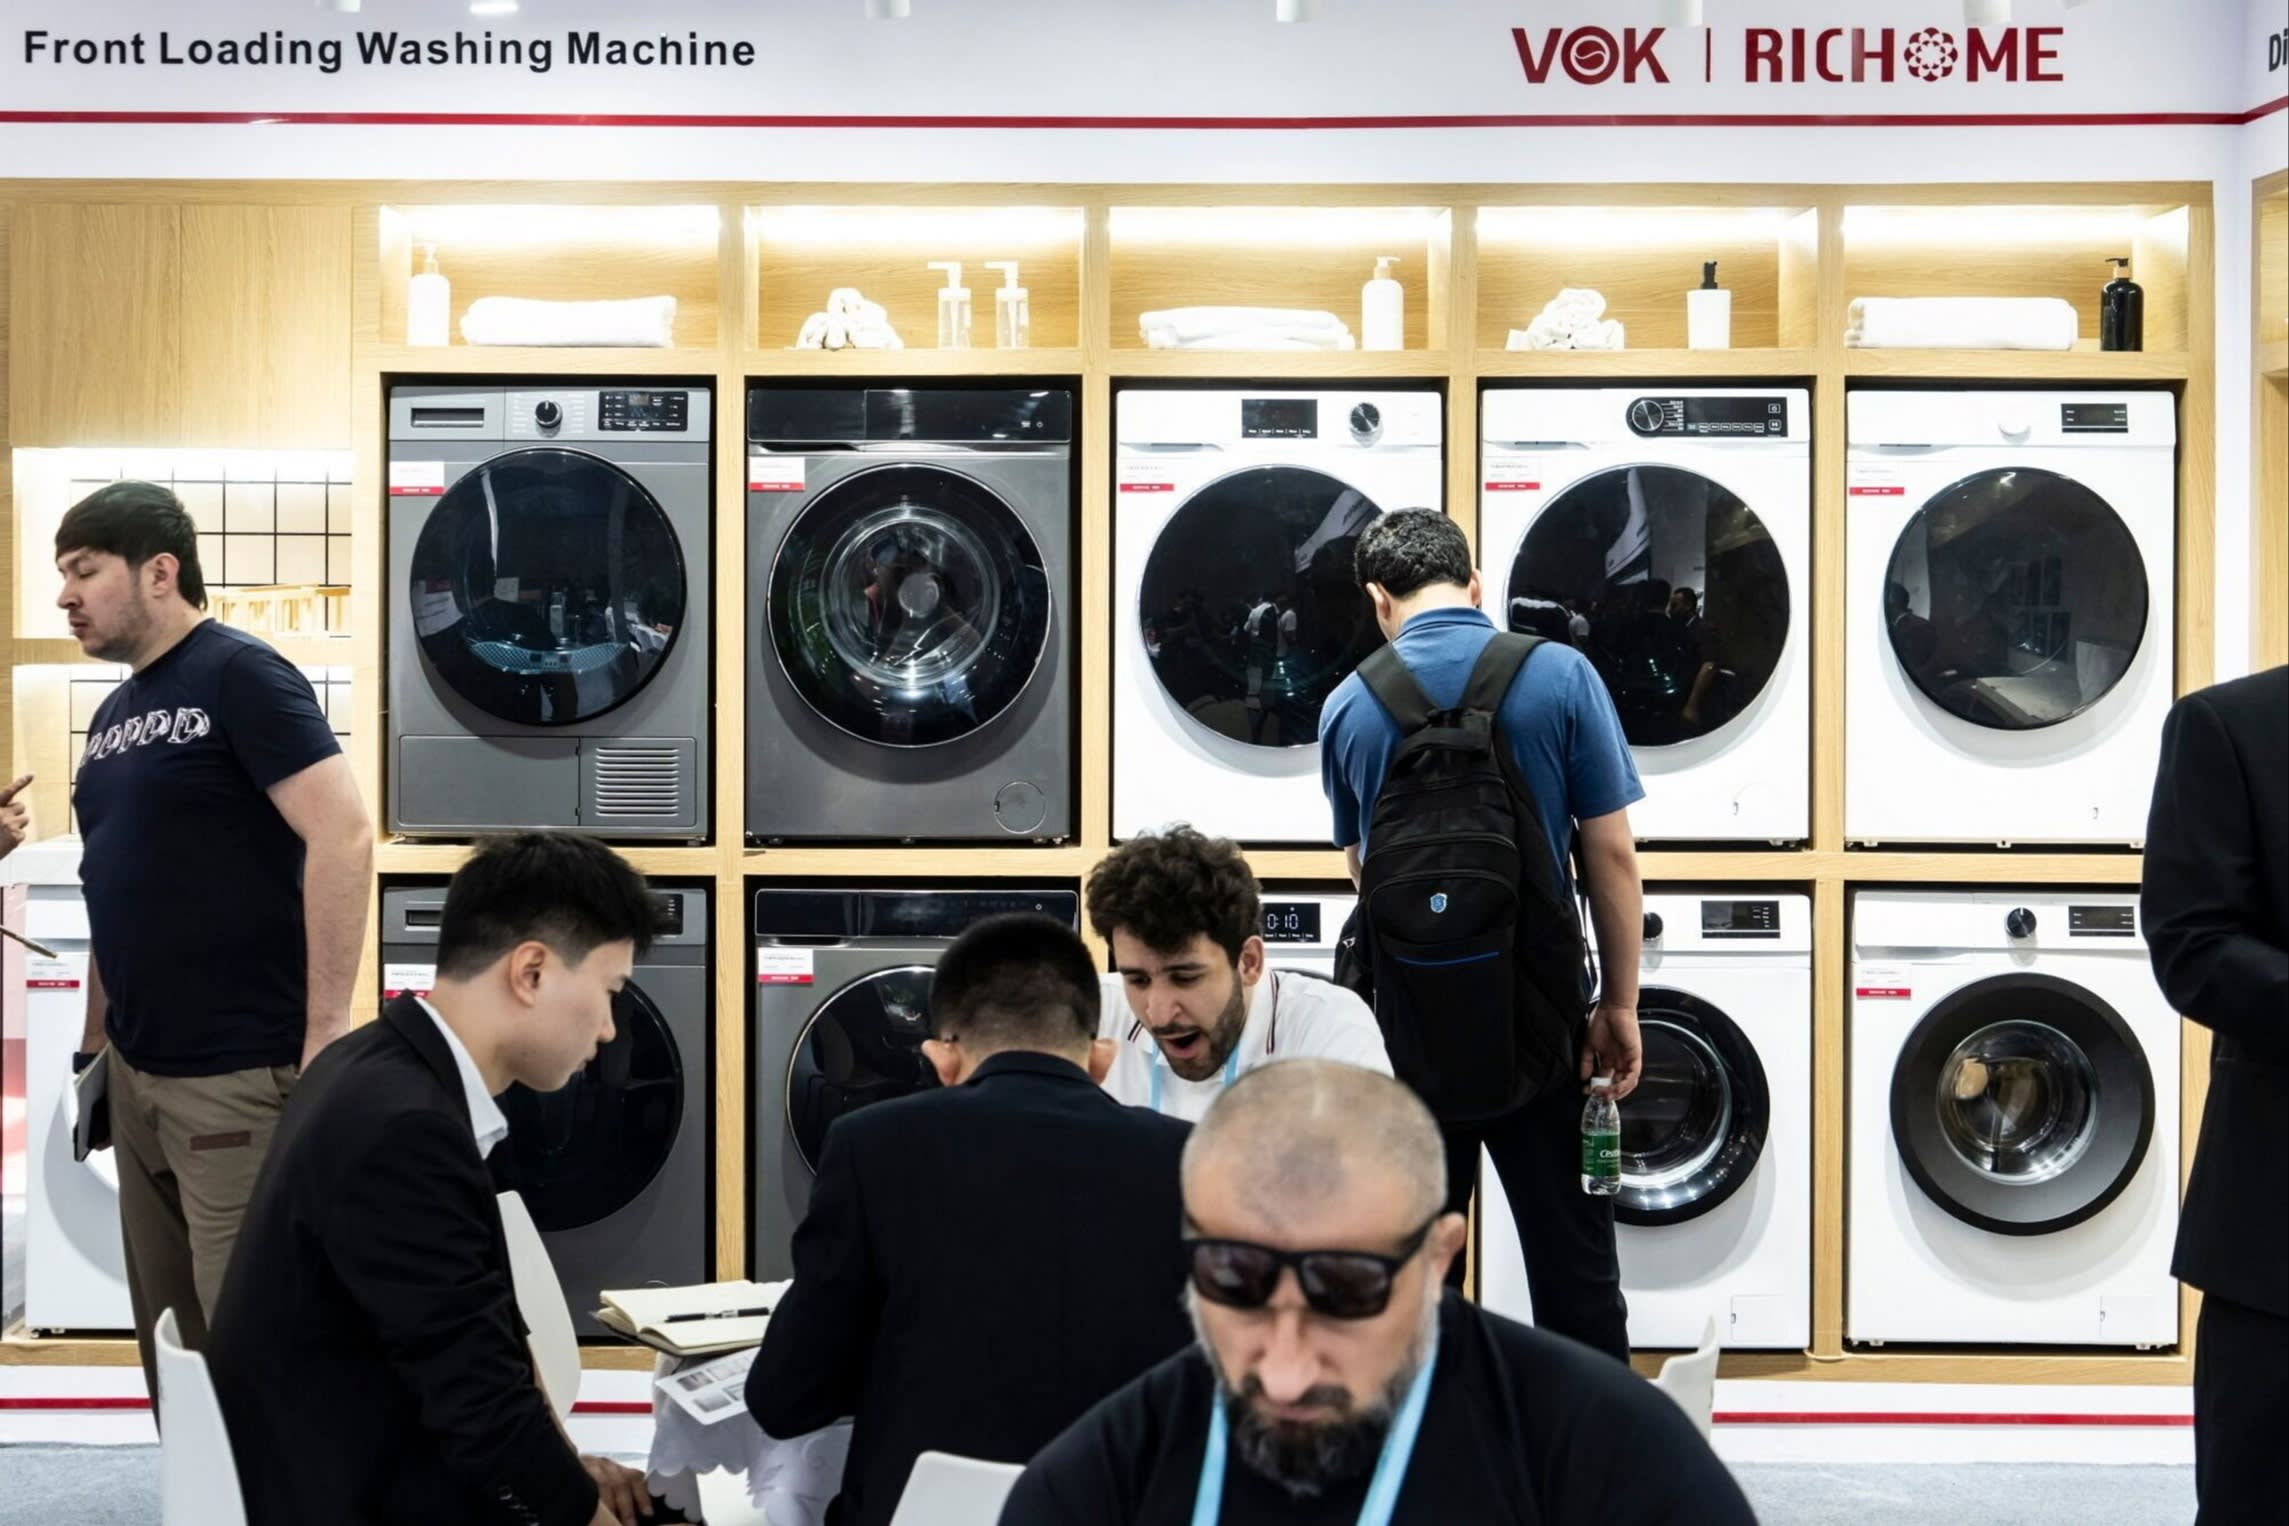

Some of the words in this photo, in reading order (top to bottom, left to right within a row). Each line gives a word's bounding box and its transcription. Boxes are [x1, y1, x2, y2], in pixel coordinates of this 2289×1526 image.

[24, 30, 145, 65] Front
[159, 31, 342, 73] Loading
[357, 31, 551, 72] Washing
[567, 31, 756, 66] Machine
[1511, 25, 1670, 84] VOK
